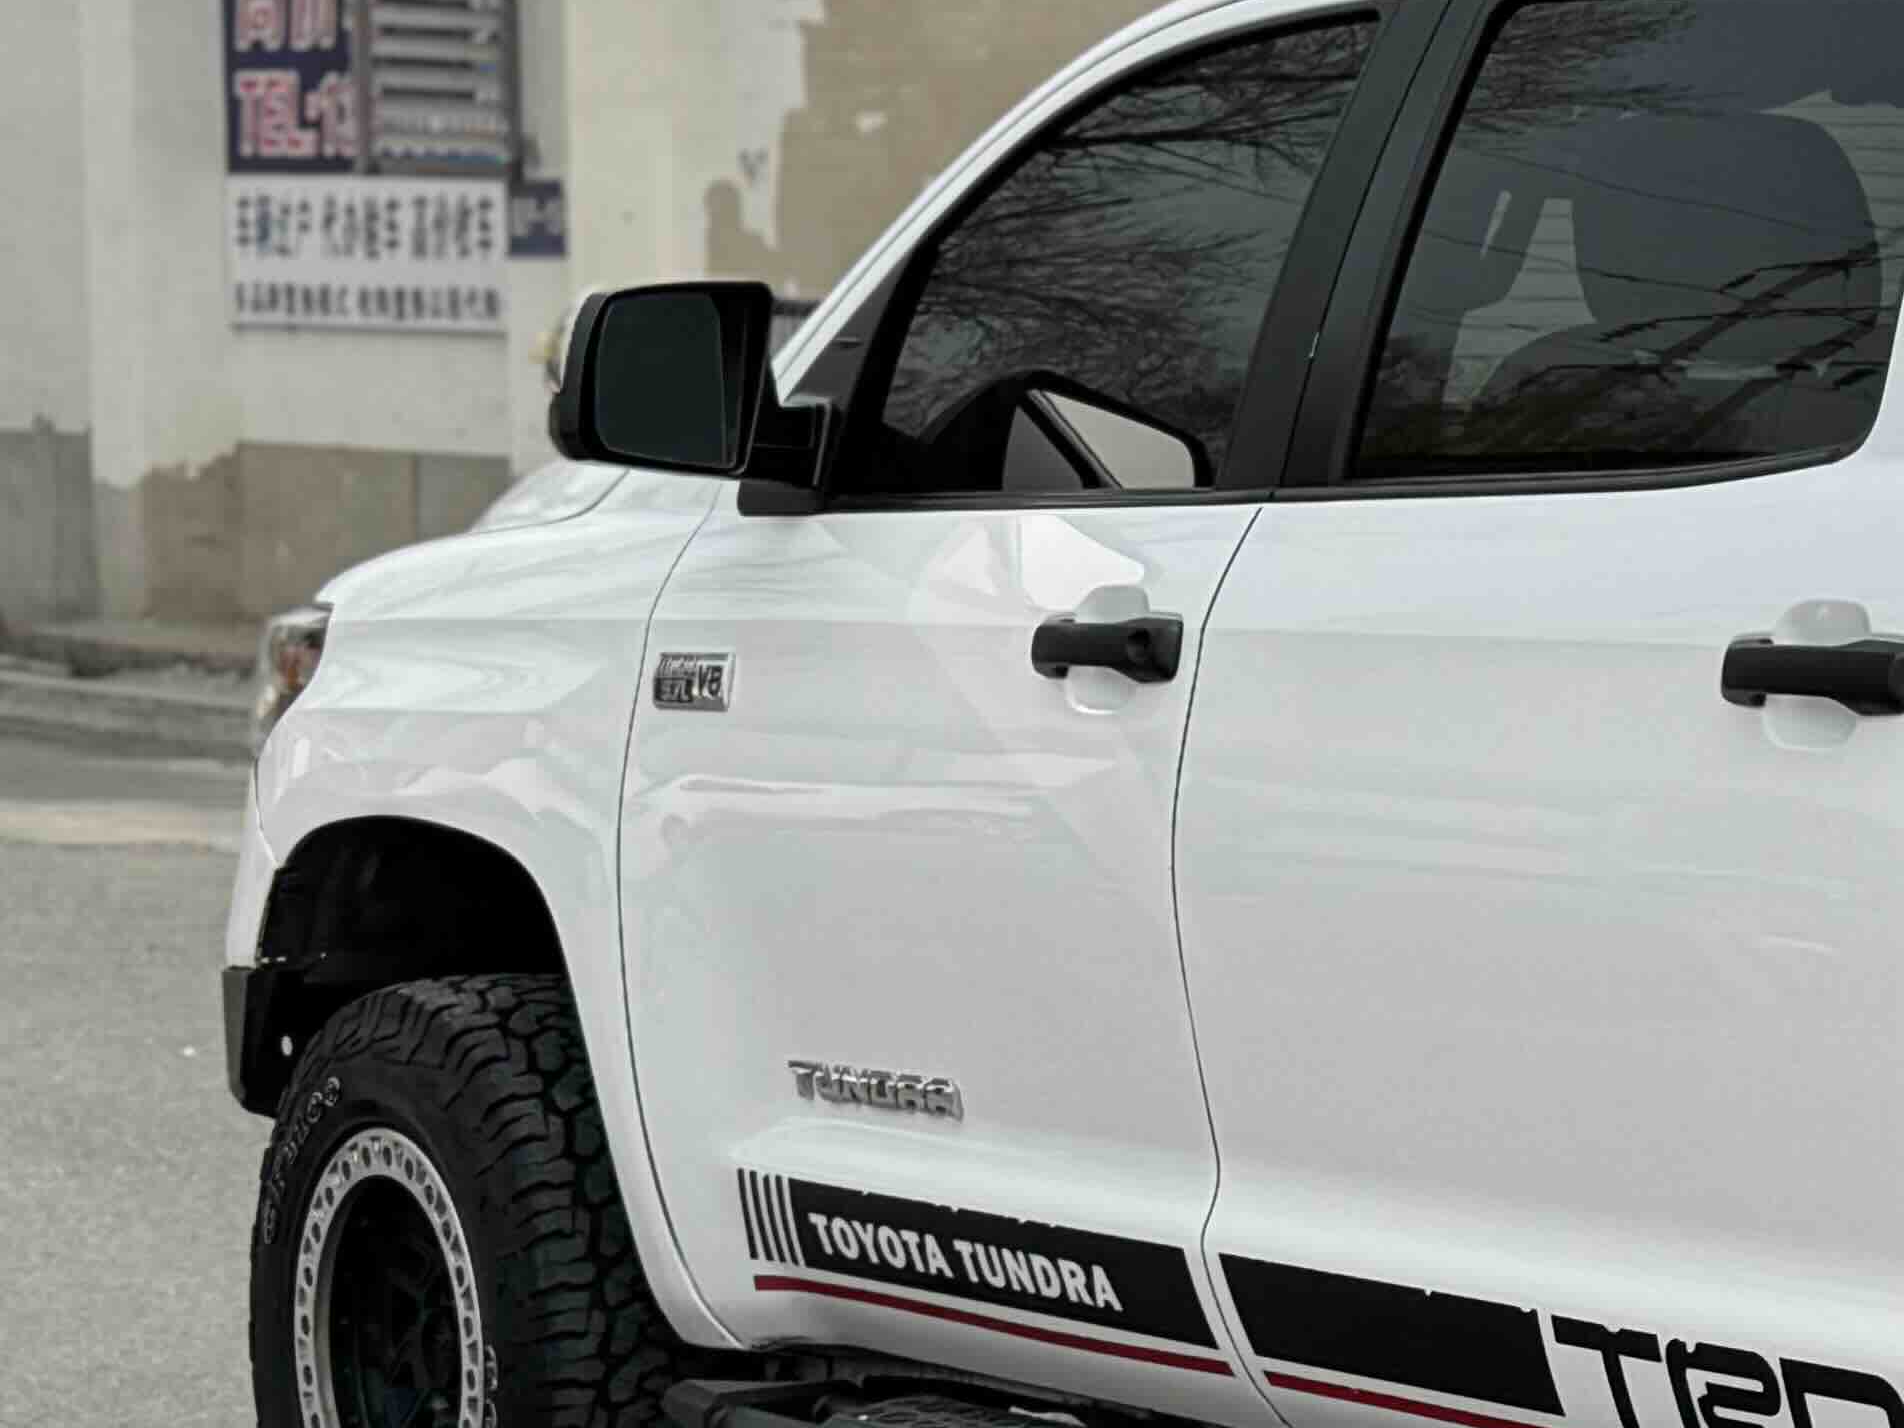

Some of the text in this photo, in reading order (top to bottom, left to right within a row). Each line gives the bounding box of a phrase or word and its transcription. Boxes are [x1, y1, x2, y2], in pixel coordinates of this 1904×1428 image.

[787, 1059, 965, 1122] TUNDRA
[807, 1211, 1124, 1312] TOYOTA TUNDRA
